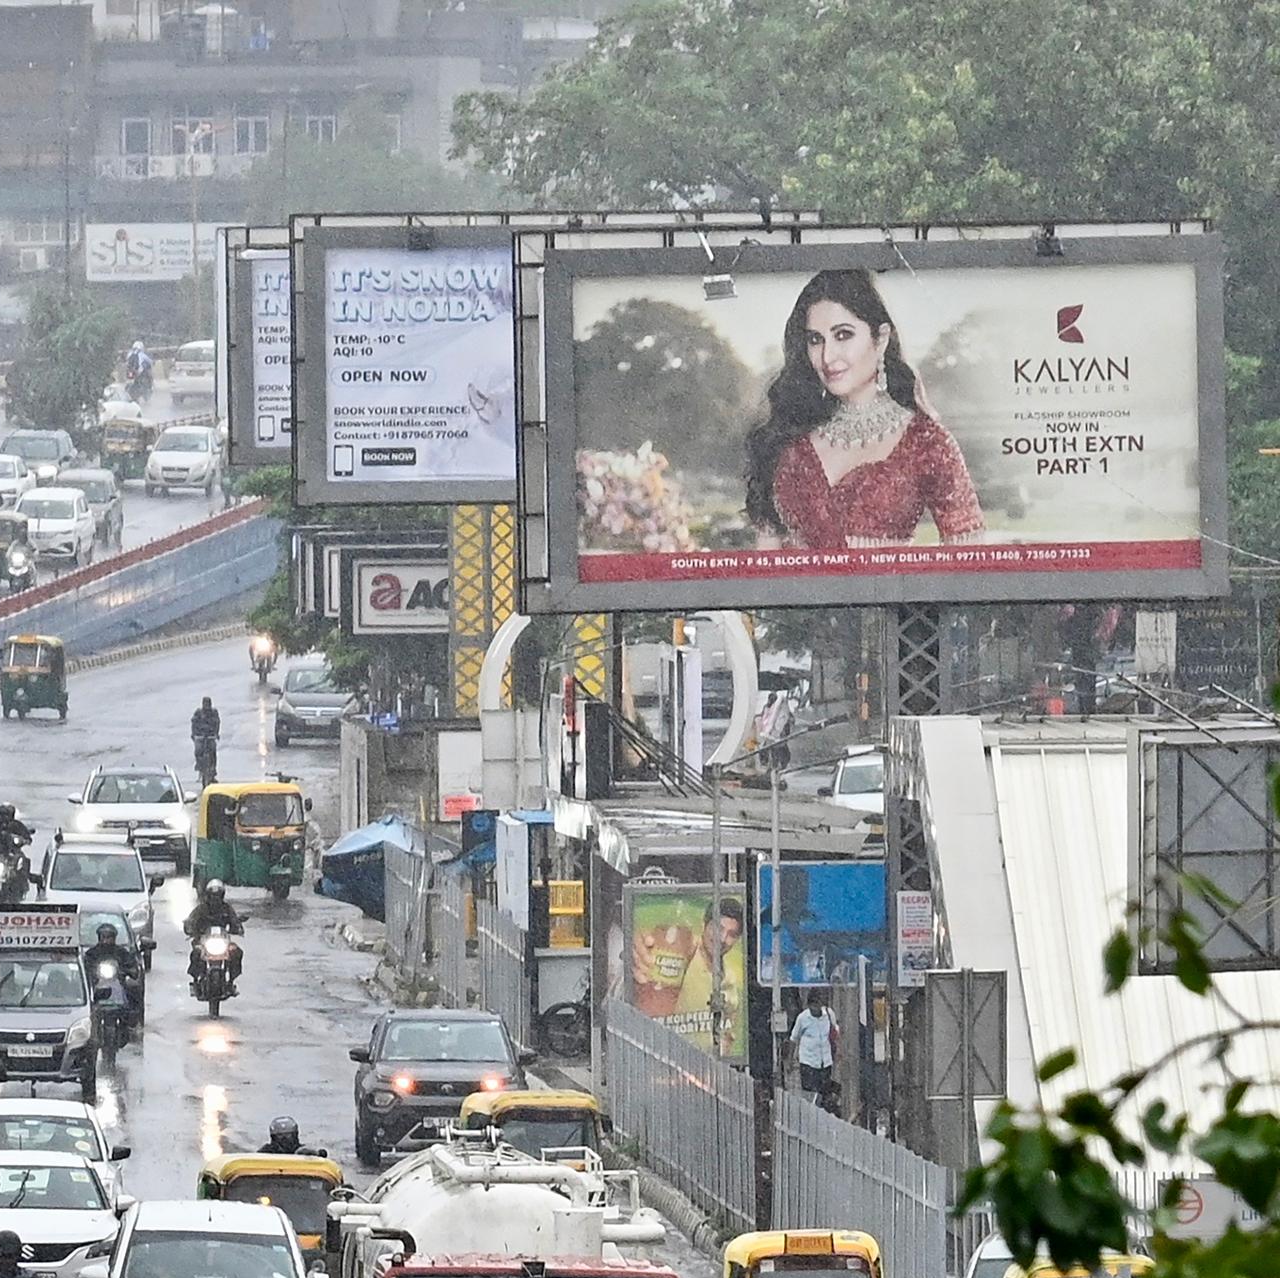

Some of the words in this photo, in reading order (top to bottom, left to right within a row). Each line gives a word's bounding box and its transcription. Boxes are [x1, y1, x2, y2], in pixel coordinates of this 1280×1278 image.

[257, 272, 290, 292] IT'
[332, 267, 392, 292] IT'S
[400, 264, 503, 292] SNOW
[257, 299, 289, 316] IN
[332, 299, 372, 322] IN
[383, 297, 496, 322] NOIDA
[333, 335, 371, 345] TEMP:
[333, 347, 358, 357] AQI:
[360, 347, 373, 356] 10
[264, 355, 289, 365] OPE
[1013, 356, 1129, 384] KALYAN
[341, 371, 383, 382] OPEN
[390, 371, 427, 382] NOW
[1014, 384, 1130, 395] JEWELLERS
[258, 404, 290, 412] Contac
[333, 406, 366, 416] BOOK
[367, 406, 398, 415] YOUR
[400, 406, 471, 415] EXPERIENCE:
[1014, 411, 1065, 421] FLAGSHIP
[1067, 410, 1131, 419] SHOWROOM
[1046, 422, 1081, 433] NOW
[1085, 421, 1099, 432] IN
[333, 431, 381, 440] Contact:
[1002, 437, 1077, 455] SOUTH
[1085, 435, 1144, 453] EXTN
[391, 452, 415, 461] NOW
[1037, 458, 1091, 475] PART
[1099, 457, 1109, 473] 1
[671, 558, 707, 569] SOUTH
[710, 557, 737, 568] EXTN
[775, 556, 810, 566] BLOCK
[824, 554, 850, 564] PART
[871, 553, 896, 563] NEW
[899, 553, 934, 563] DELHI.
[936, 552, 953, 562] PH:
[956, 551, 986, 561] 99711
[0, 916, 71, 926] JOHAR
